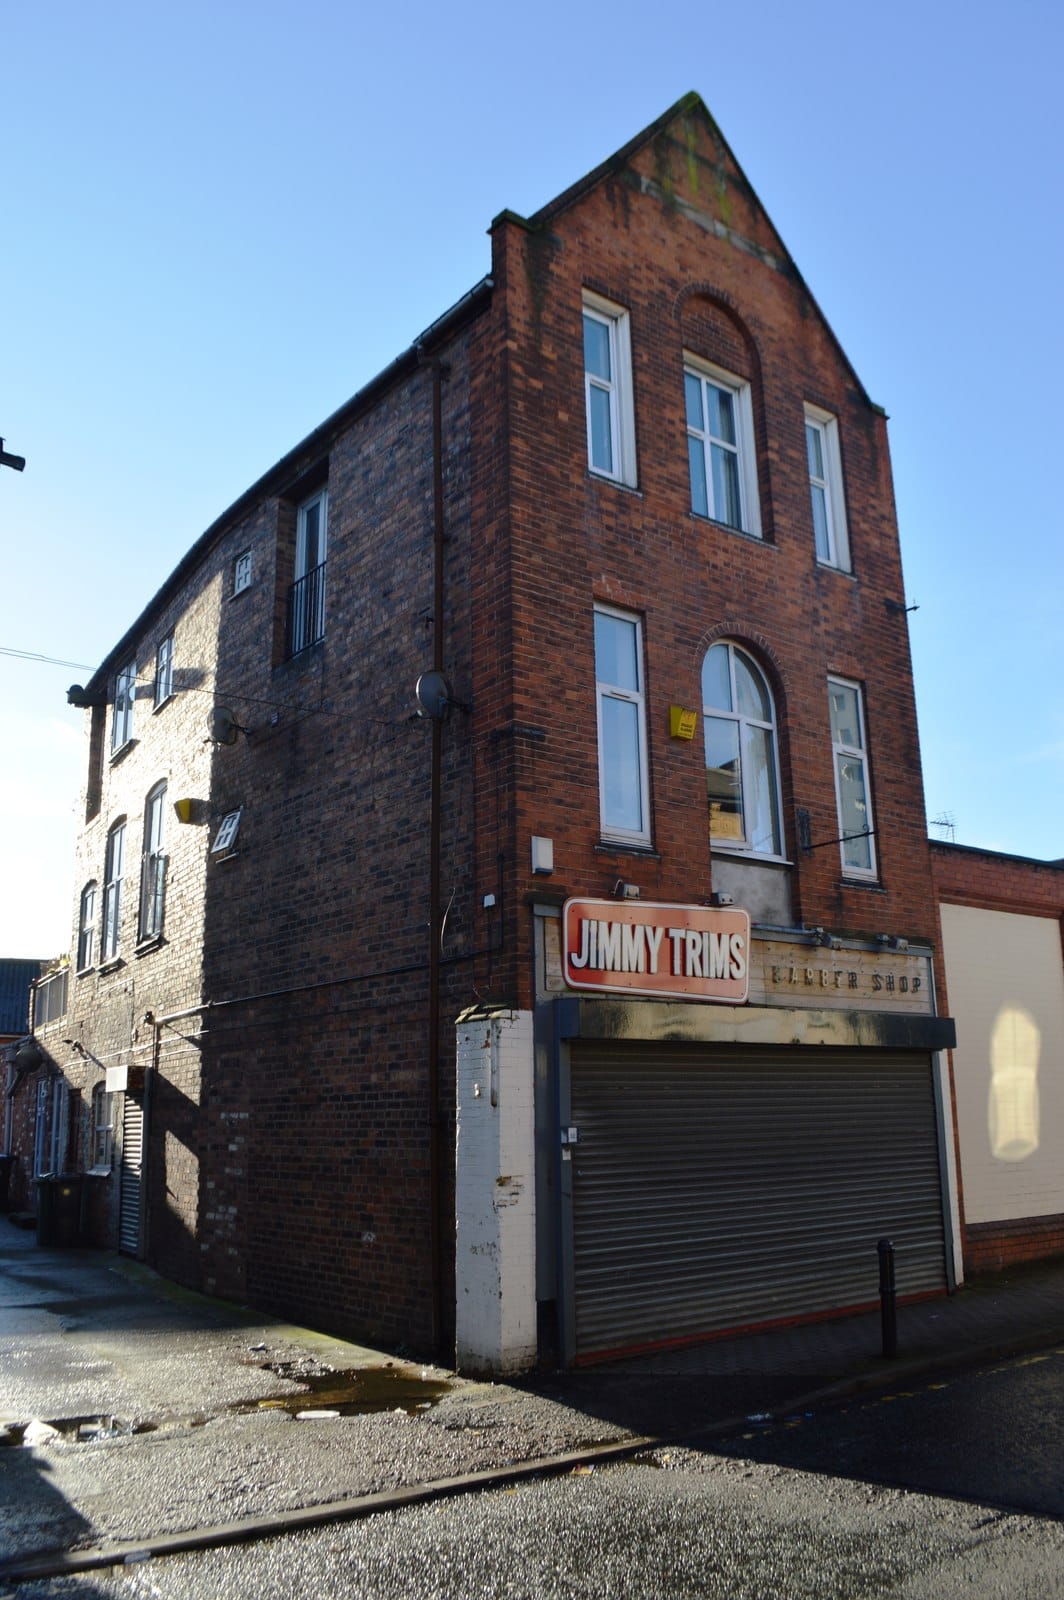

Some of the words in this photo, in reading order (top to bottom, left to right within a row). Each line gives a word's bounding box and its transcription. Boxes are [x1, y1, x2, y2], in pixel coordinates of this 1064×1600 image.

[571, 919, 664, 974] JIMMY
[668, 927, 746, 980] TRIMS
[771, 965, 858, 989] BARBER
[872, 972, 921, 994] SHOP
